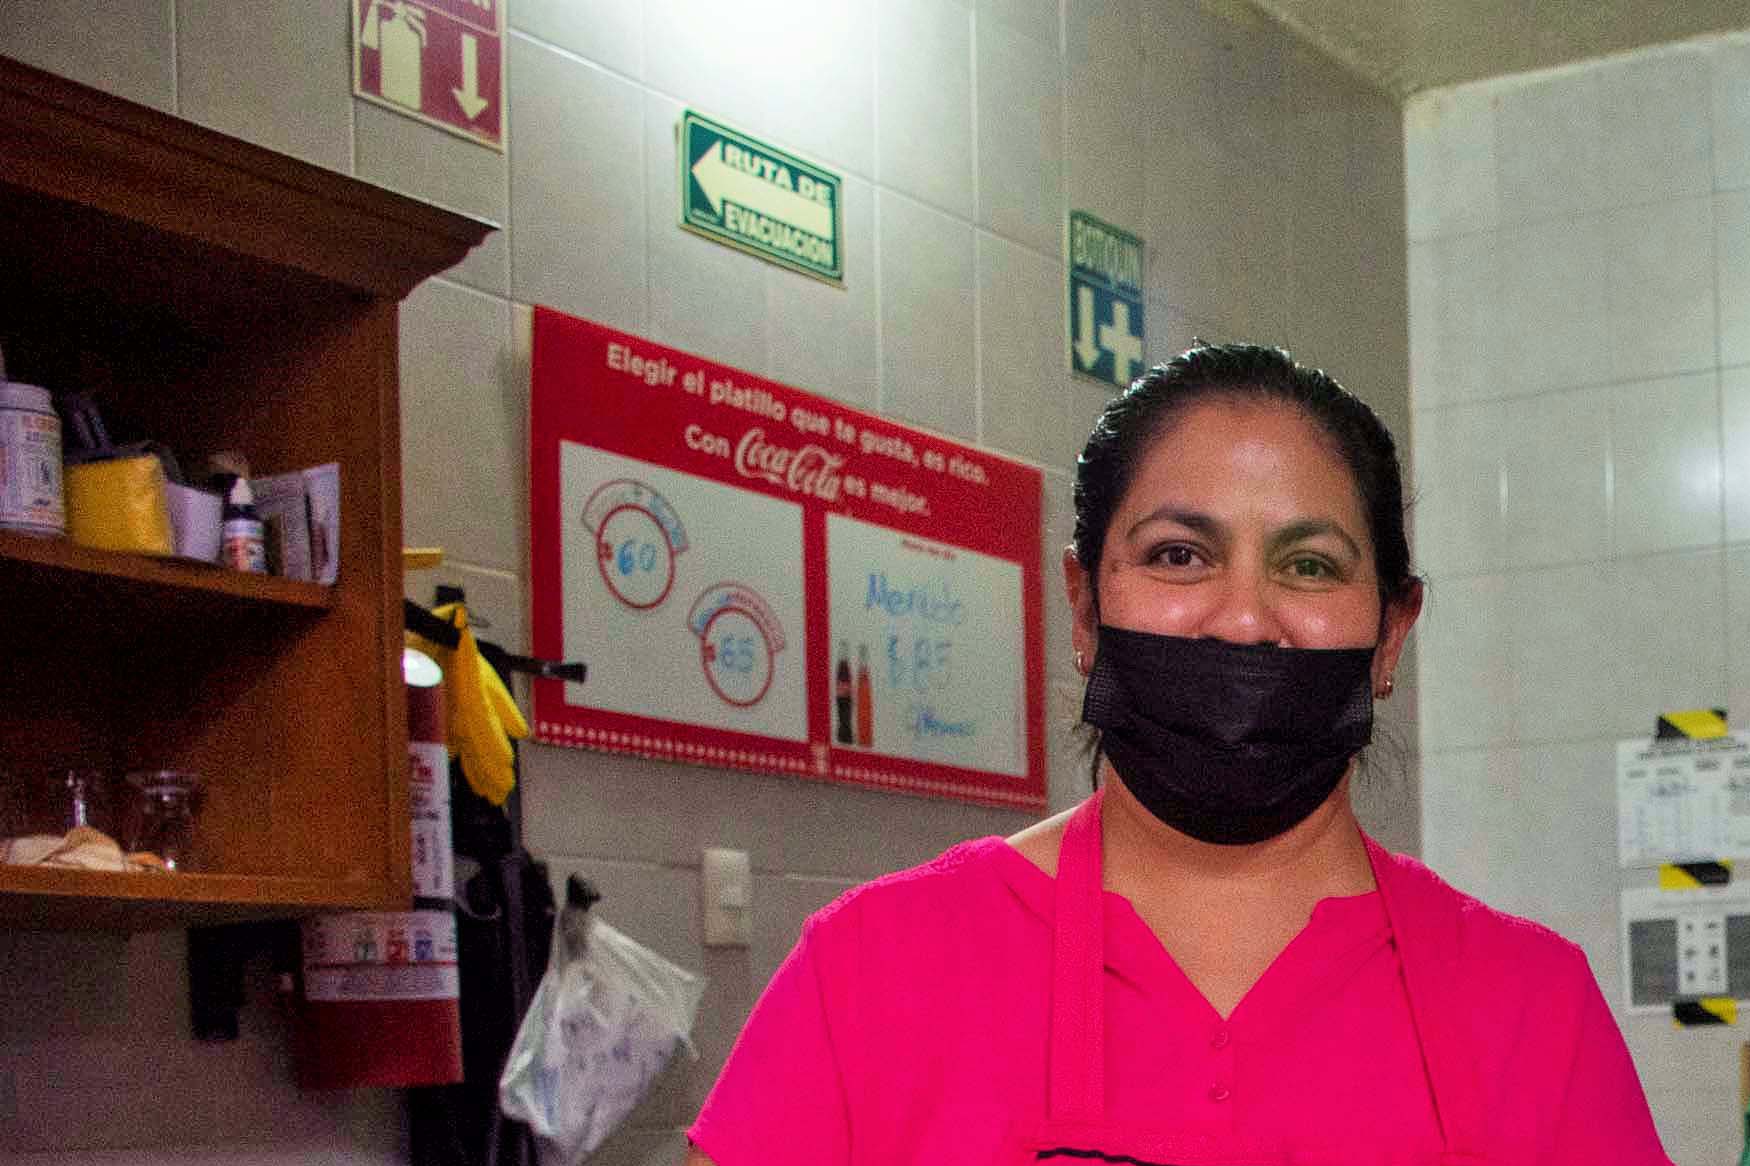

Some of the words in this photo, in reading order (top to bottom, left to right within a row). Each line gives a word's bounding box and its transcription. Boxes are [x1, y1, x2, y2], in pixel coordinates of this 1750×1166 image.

[725, 143, 795, 192] RUTA
[798, 174, 833, 208] DE
[606, 341, 678, 388] Elegir
[682, 369, 705, 397] el
[709, 378, 787, 423] platillo
[790, 407, 832, 438] que
[834, 416, 857, 445] te
[859, 430, 920, 469] gusta,
[922, 449, 946, 473] es
[684, 423, 731, 459] Con
[843, 474, 868, 498] es
[615, 535, 657, 577] 60
